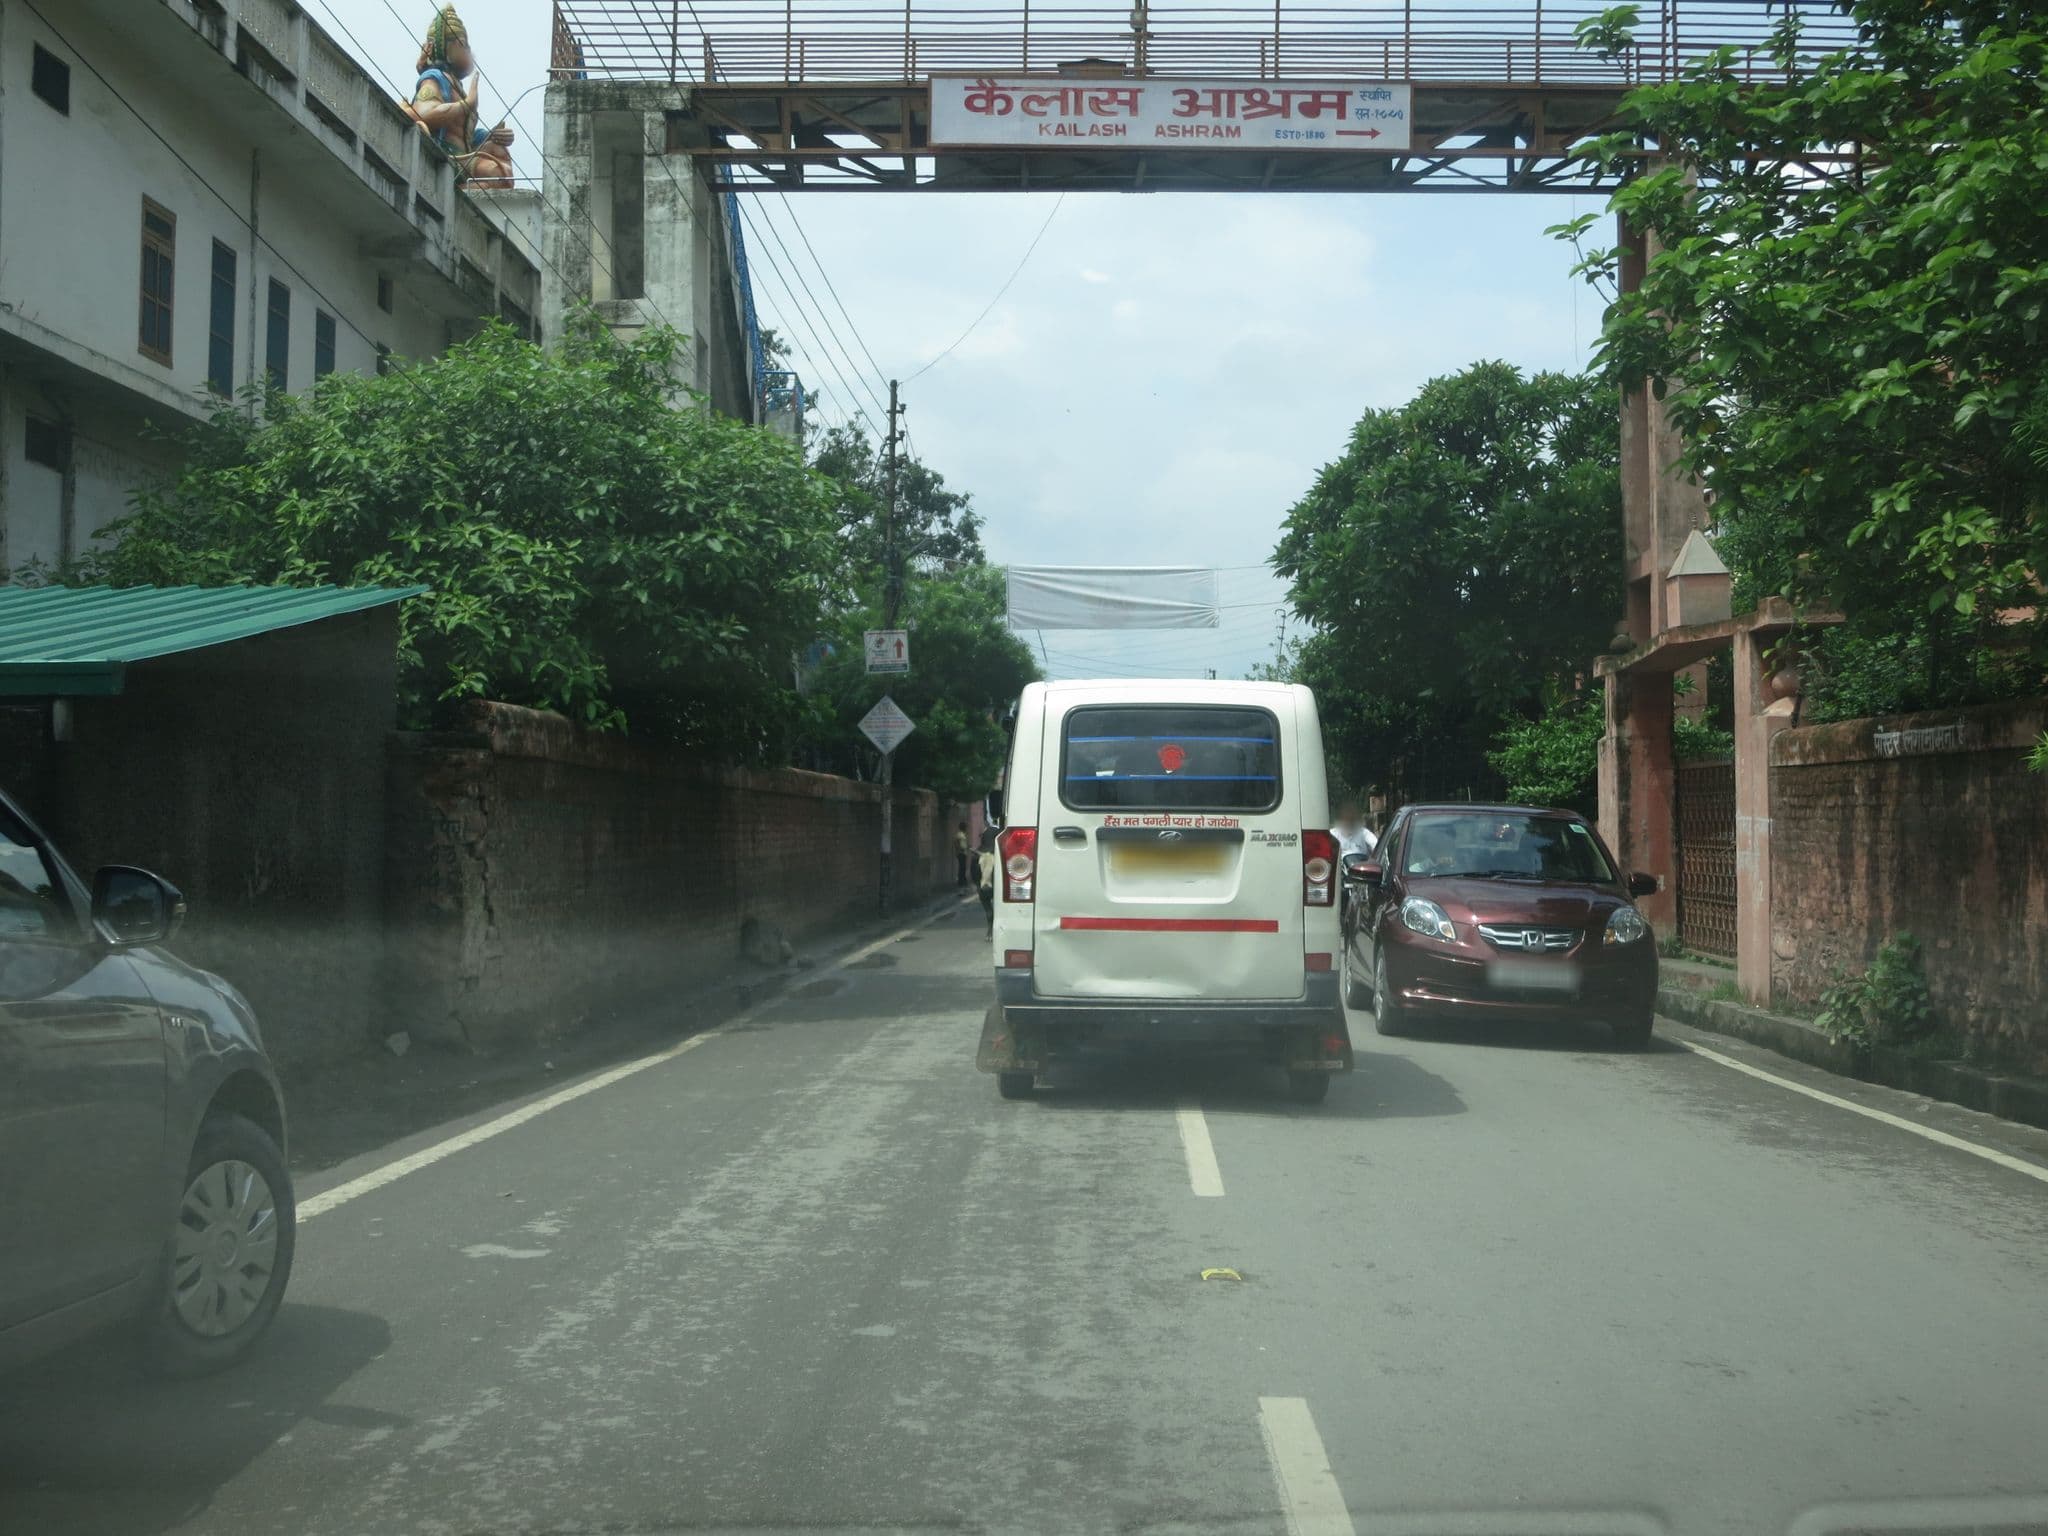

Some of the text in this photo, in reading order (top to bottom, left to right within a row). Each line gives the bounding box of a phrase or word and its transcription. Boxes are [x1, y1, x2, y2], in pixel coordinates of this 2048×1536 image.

[964, 79, 1353, 120] कैलास आश्रम
[1038, 122, 1241, 138] KAILASH ASHRAM
